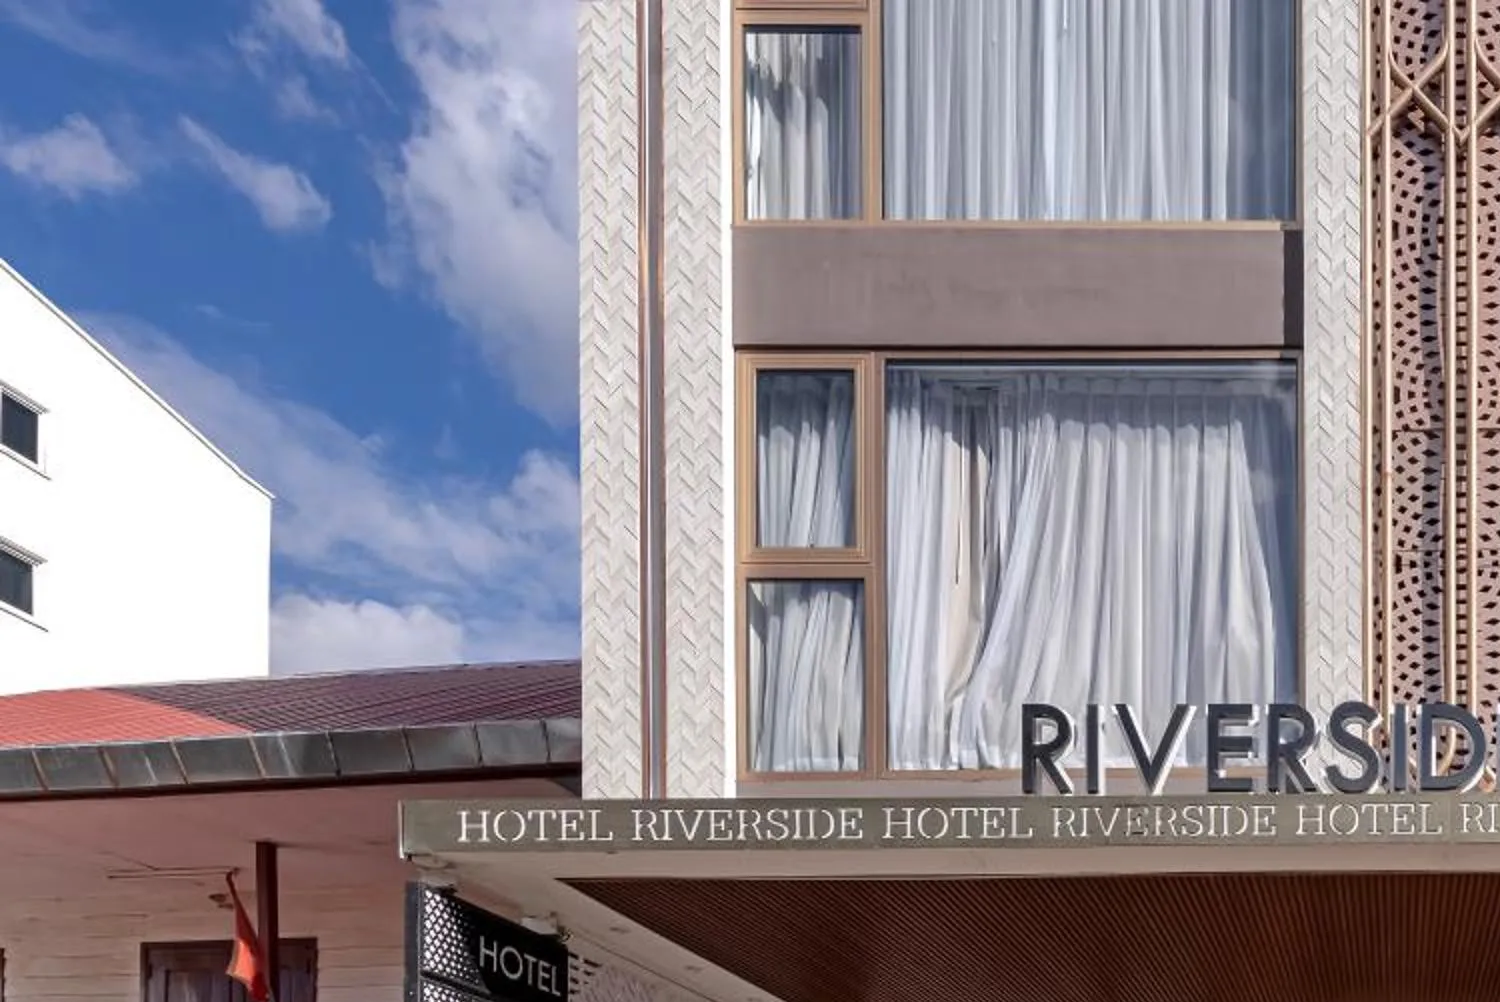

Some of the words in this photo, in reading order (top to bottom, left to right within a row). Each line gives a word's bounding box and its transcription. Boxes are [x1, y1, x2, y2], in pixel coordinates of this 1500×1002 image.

[457, 808, 614, 843] HOTEL
[631, 807, 864, 842] RIVERSIDE
[881, 806, 1033, 840] HOTEL
[1051, 804, 1277, 838] RIVERSIDE
[1295, 802, 1444, 836] HOTEL
[478, 935, 562, 997] HOTEL
